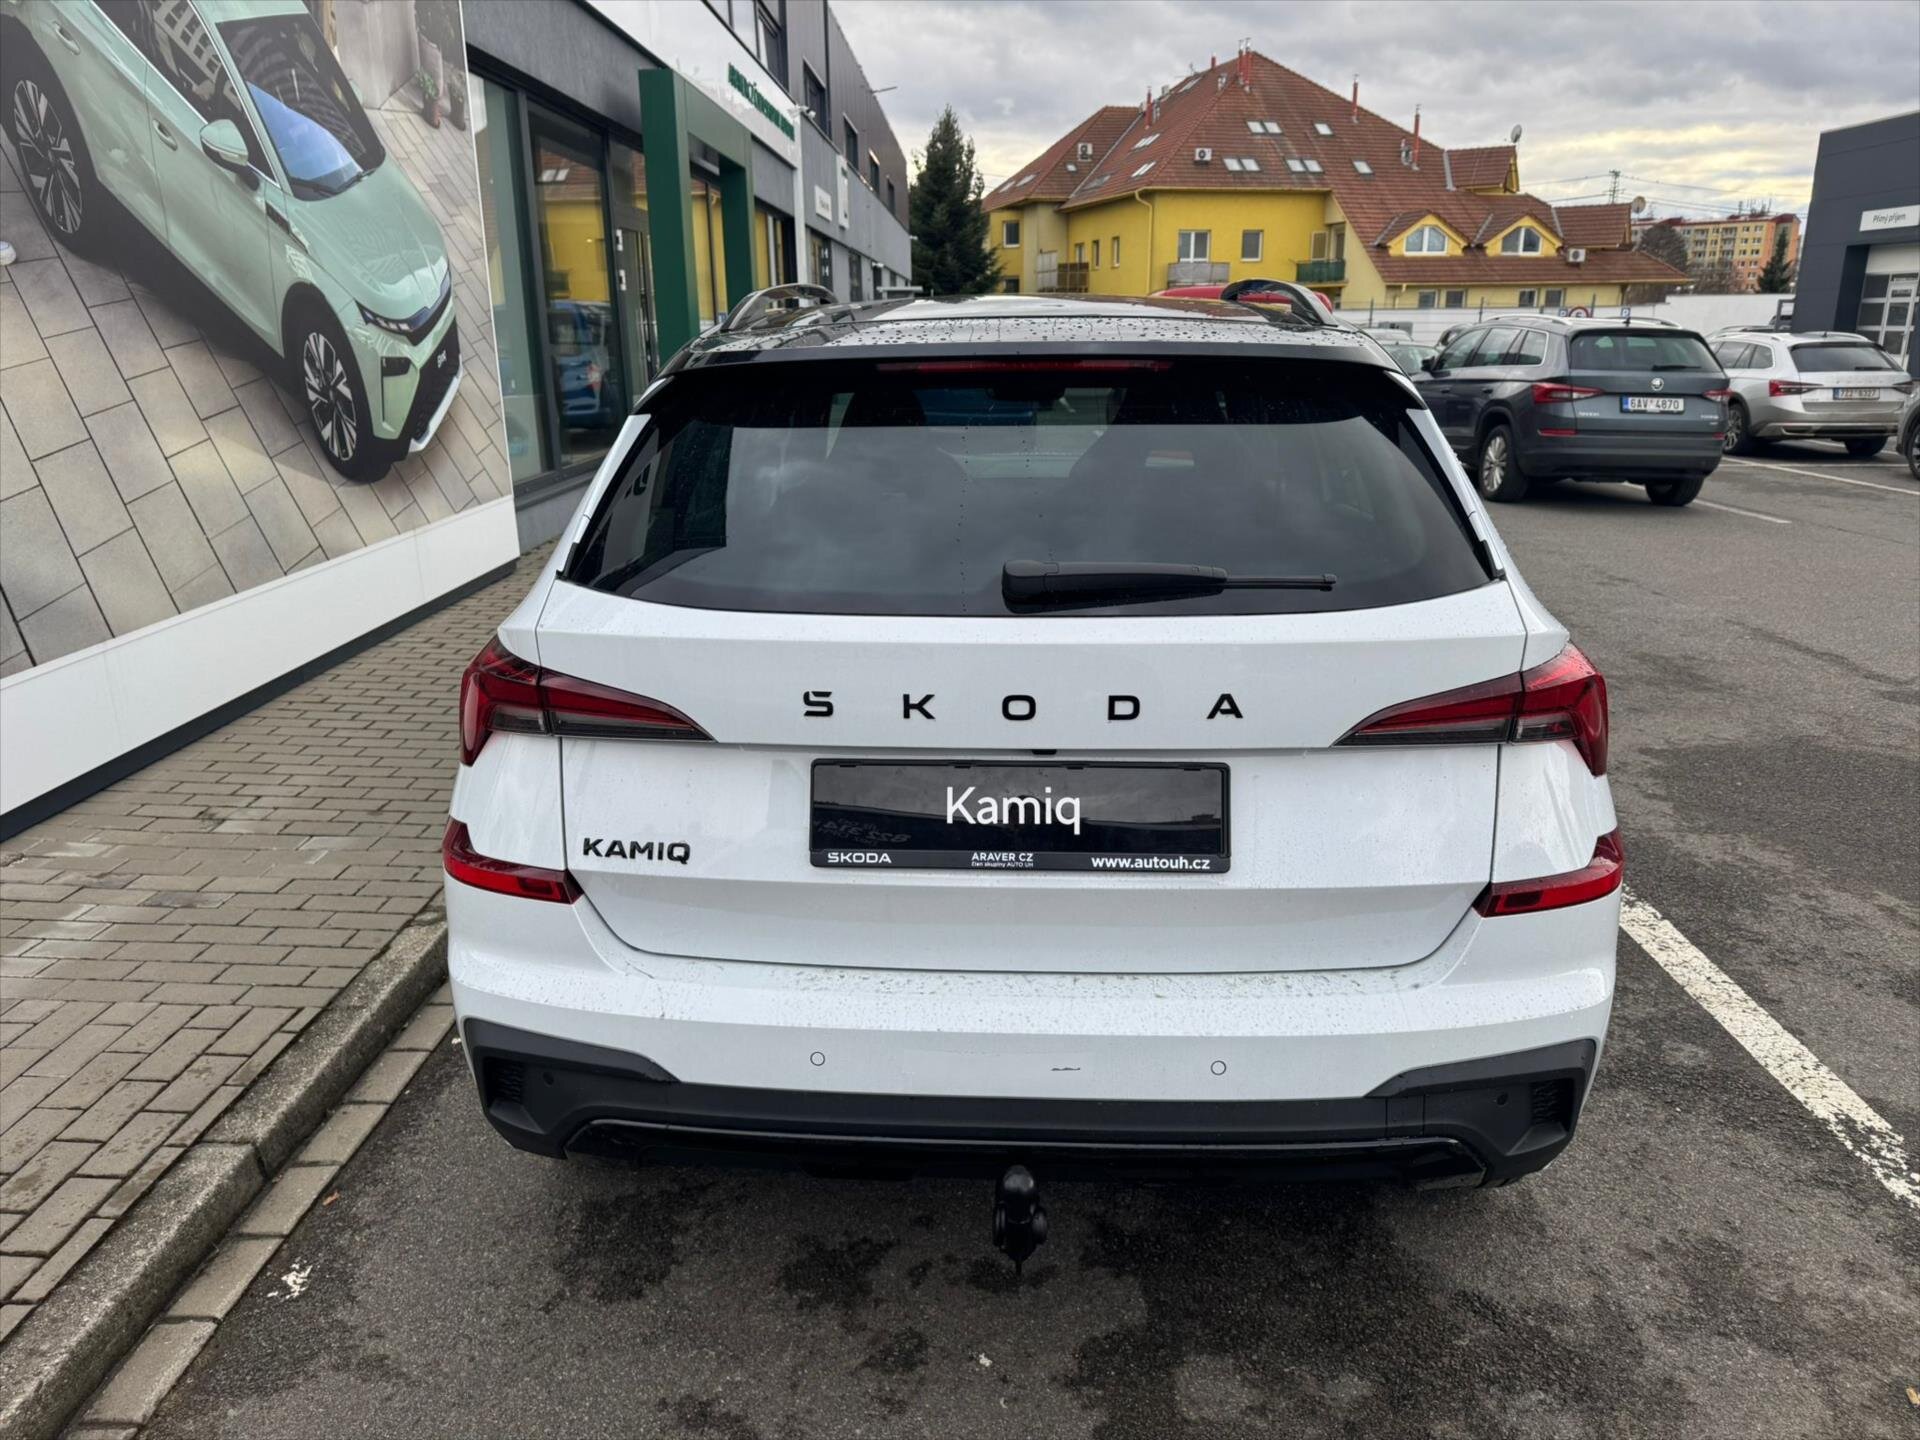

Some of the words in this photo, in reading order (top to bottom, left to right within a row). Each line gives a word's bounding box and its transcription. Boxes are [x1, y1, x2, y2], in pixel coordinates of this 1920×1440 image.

[1630, 399, 1648, 408] 6AV
[1655, 399, 1680, 410] 4870
[946, 786, 1080, 835] Kamiq
[583, 838, 690, 864] KAMIQ
[971, 852, 1016, 861] ARAVER
[1019, 852, 1034, 862] CZ
[1091, 856, 1211, 870] www.autouh.cz
